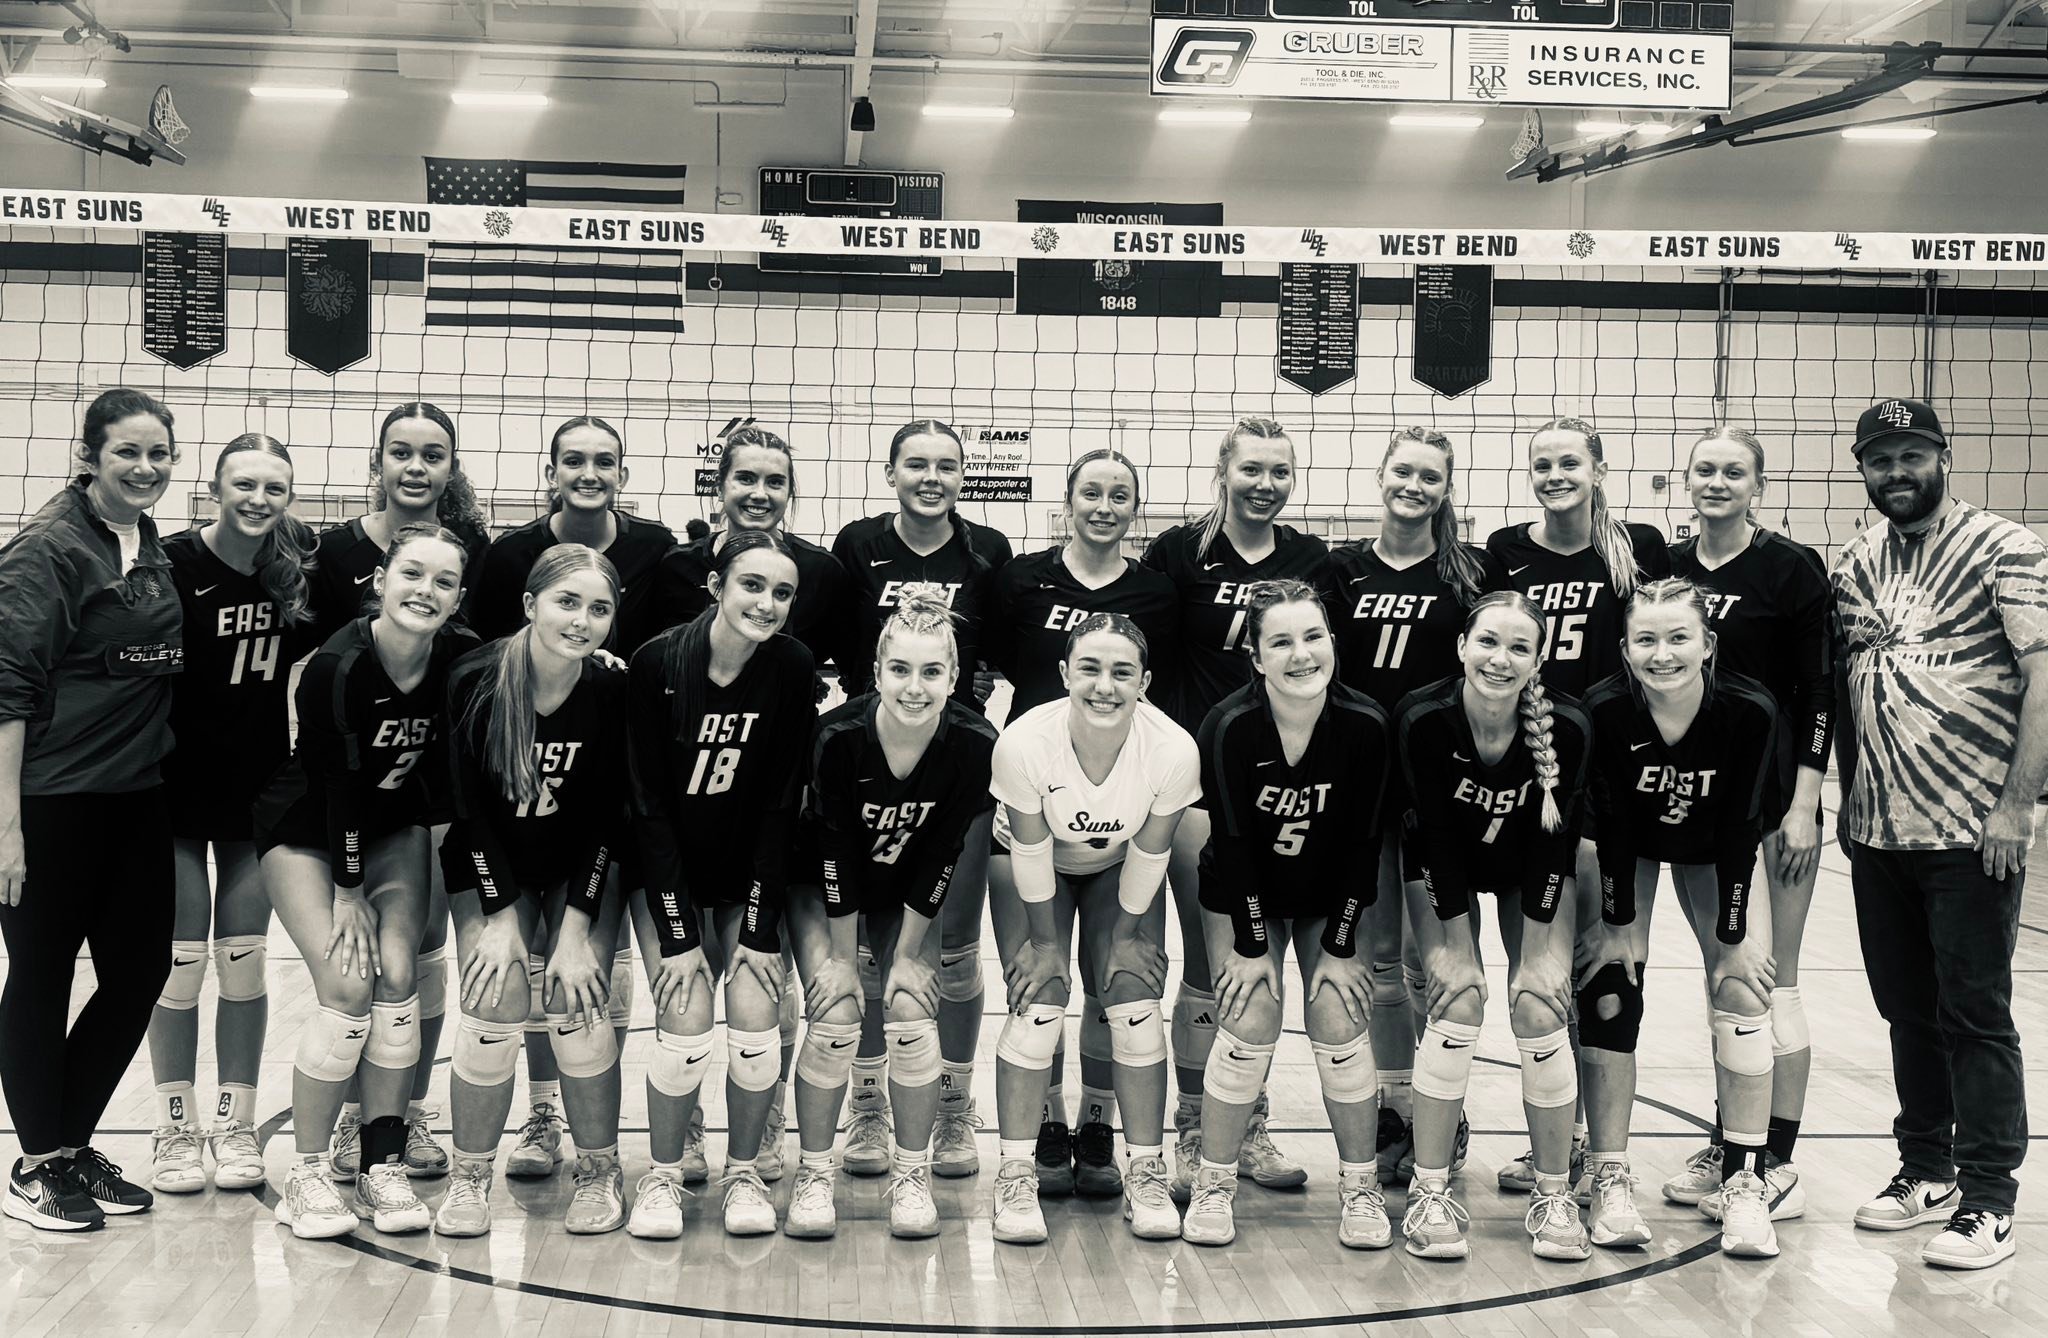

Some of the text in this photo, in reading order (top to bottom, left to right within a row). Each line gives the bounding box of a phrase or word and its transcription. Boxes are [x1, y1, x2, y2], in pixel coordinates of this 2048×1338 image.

[1348, 1, 1377, 16] TOL
[1511, 5, 1539, 21] TOL
[1284, 31, 1424, 56] GRUBER
[1530, 45, 1705, 65] INSURANCE
[1315, 69, 1338, 77] TOOL
[1528, 69, 1700, 90] SERVICES, INC.
[764, 172, 803, 184] HOME
[898, 176, 939, 188] VISITOR
[3, 195, 143, 222] EAST SUNS
[286, 206, 431, 233] WEST BEND
[1076, 212, 1164, 225] WISCONSIN
[568, 217, 705, 243] EAST SUNS
[840, 225, 980, 250] WEST BEND
[1113, 231, 1245, 255] EAST SUNS
[1379, 234, 1518, 257] WEST BEND
[1649, 236, 1781, 258] EAST SUNS
[1911, 239, 2046, 262] WEST BEND
[910, 263, 928, 273] WON
[1099, 295, 1137, 310] 1848
[979, 430, 1030, 441] RAMS
[696, 443, 723, 456] MO
[698, 473, 719, 481] Prou
[965, 463, 1019, 471] ANYWHERE!
[960, 491, 971, 499] est
[972, 491, 993, 500] Bend
[962, 479, 978, 488] oud
[979, 479, 1018, 488] supporter
[1677, 528, 1689, 537] 43
[1214, 582, 1253, 605] EA
[1353, 593, 1438, 620] EAST
[1526, 581, 1605, 611] EAST
[217, 602, 285, 637] EAS
[1044, 604, 1130, 632] EA
[1705, 594, 1742, 620] ST
[1372, 624, 1412, 669] 11
[1543, 614, 1588, 662] 15
[120, 648, 184, 662] VOLLEYB
[229, 635, 281, 684] 14
[372, 714, 432, 747] EAS
[697, 713, 760, 743] AST
[1811, 711, 1827, 754] ST SUNS
[377, 750, 424, 789] 2
[686, 747, 741, 795] 18
[1636, 765, 1717, 798] EAST
[1256, 783, 1332, 817] EAST
[1453, 777, 1534, 814] EAST
[861, 801, 937, 830] EAST
[1068, 811, 1125, 833] Suns
[1659, 793, 1693, 825] 3
[1273, 820, 1311, 857] 5
[1481, 817, 1504, 844] 1
[345, 830, 360, 873] WE ARE
[471, 851, 499, 897] WE ARE
[585, 846, 608, 899] EAST SUNS
[929, 865, 954, 904] ST SUNS
[826, 882, 841, 903] WE
[1541, 885, 1557, 909] SUNS
[661, 892, 686, 939] WE ARE
[747, 905, 758, 932] SUNS
[1246, 895, 1262, 919] ARE
[1728, 883, 1743, 931] EAST SUNS
[1335, 898, 1358, 946] EAST SUNS
